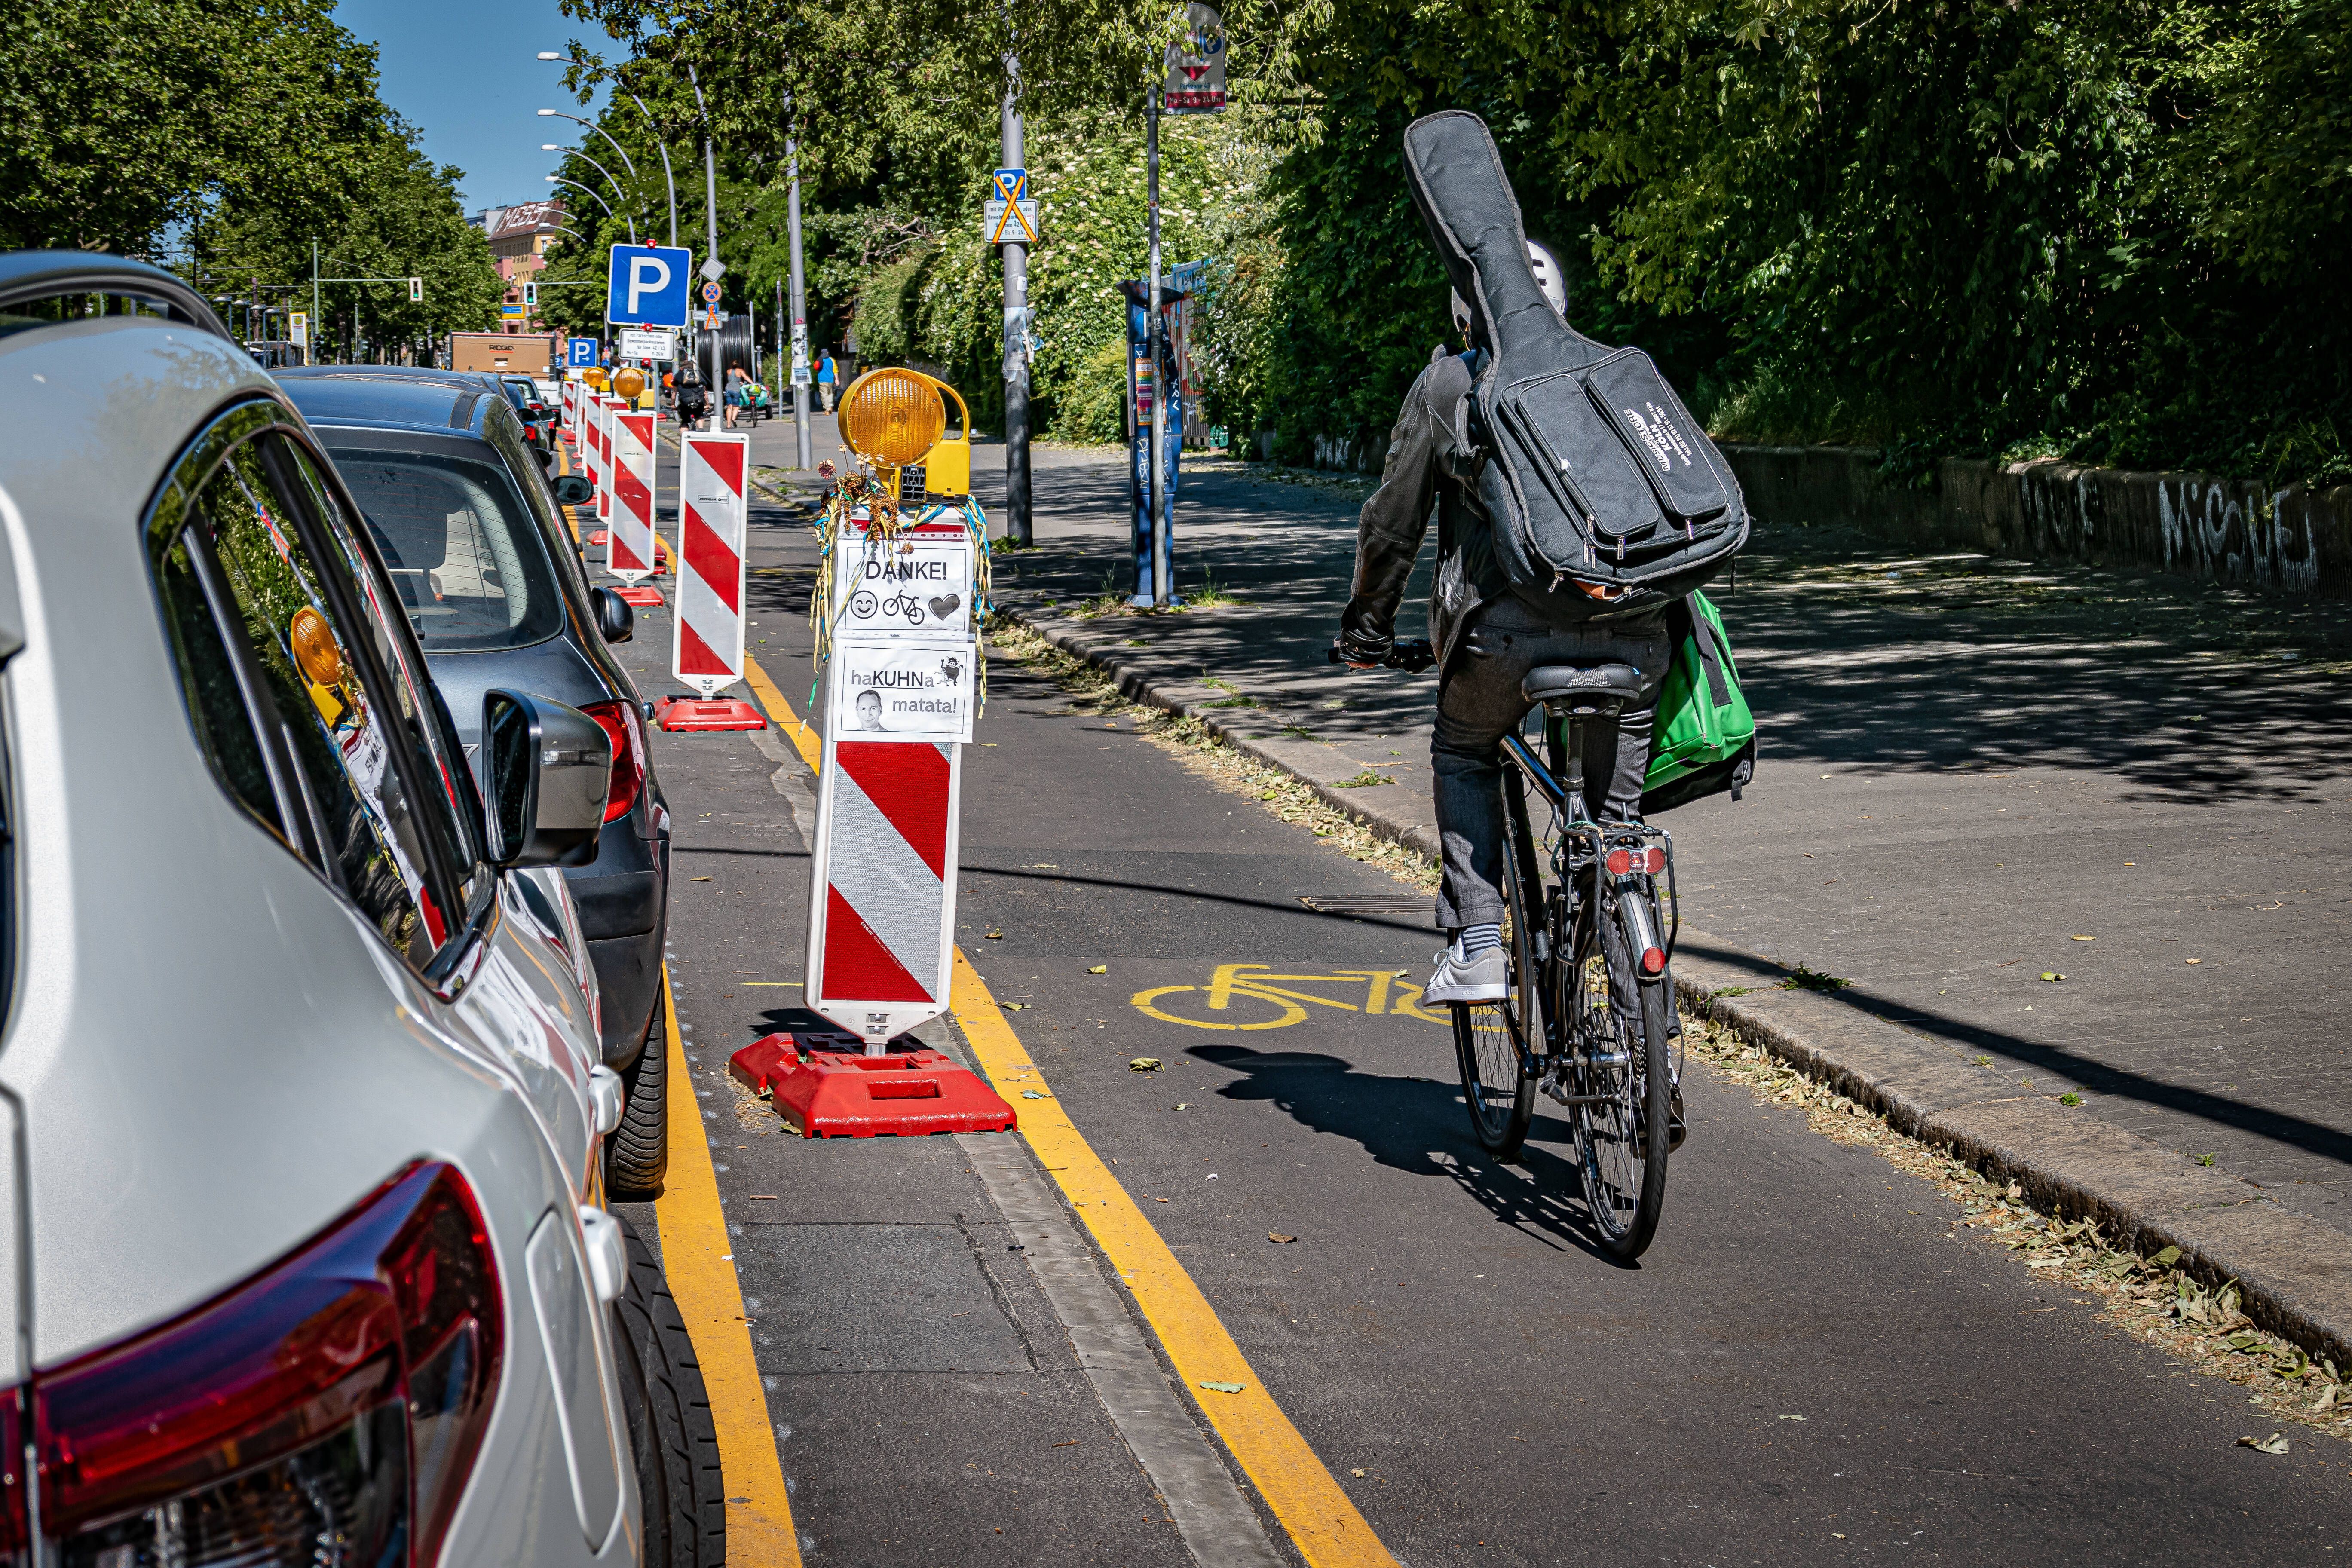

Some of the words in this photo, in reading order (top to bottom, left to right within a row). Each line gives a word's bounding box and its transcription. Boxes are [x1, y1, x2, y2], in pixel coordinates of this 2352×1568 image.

[628, 256, 671, 314] P
[575, 342, 591, 363] P
[1646, 401, 1654, 412] Köln
[1623, 409, 1648, 441] STORE
[1649, 424, 1672, 451] KÖLN
[1665, 432, 1683, 455] Budengasse
[1645, 441, 1669, 471] MUSIC
[1680, 453, 1691, 466] Große
[866, 560, 946, 580] DANKE!
[851, 669, 934, 687] haKUHNa
[892, 698, 957, 713] matata!
